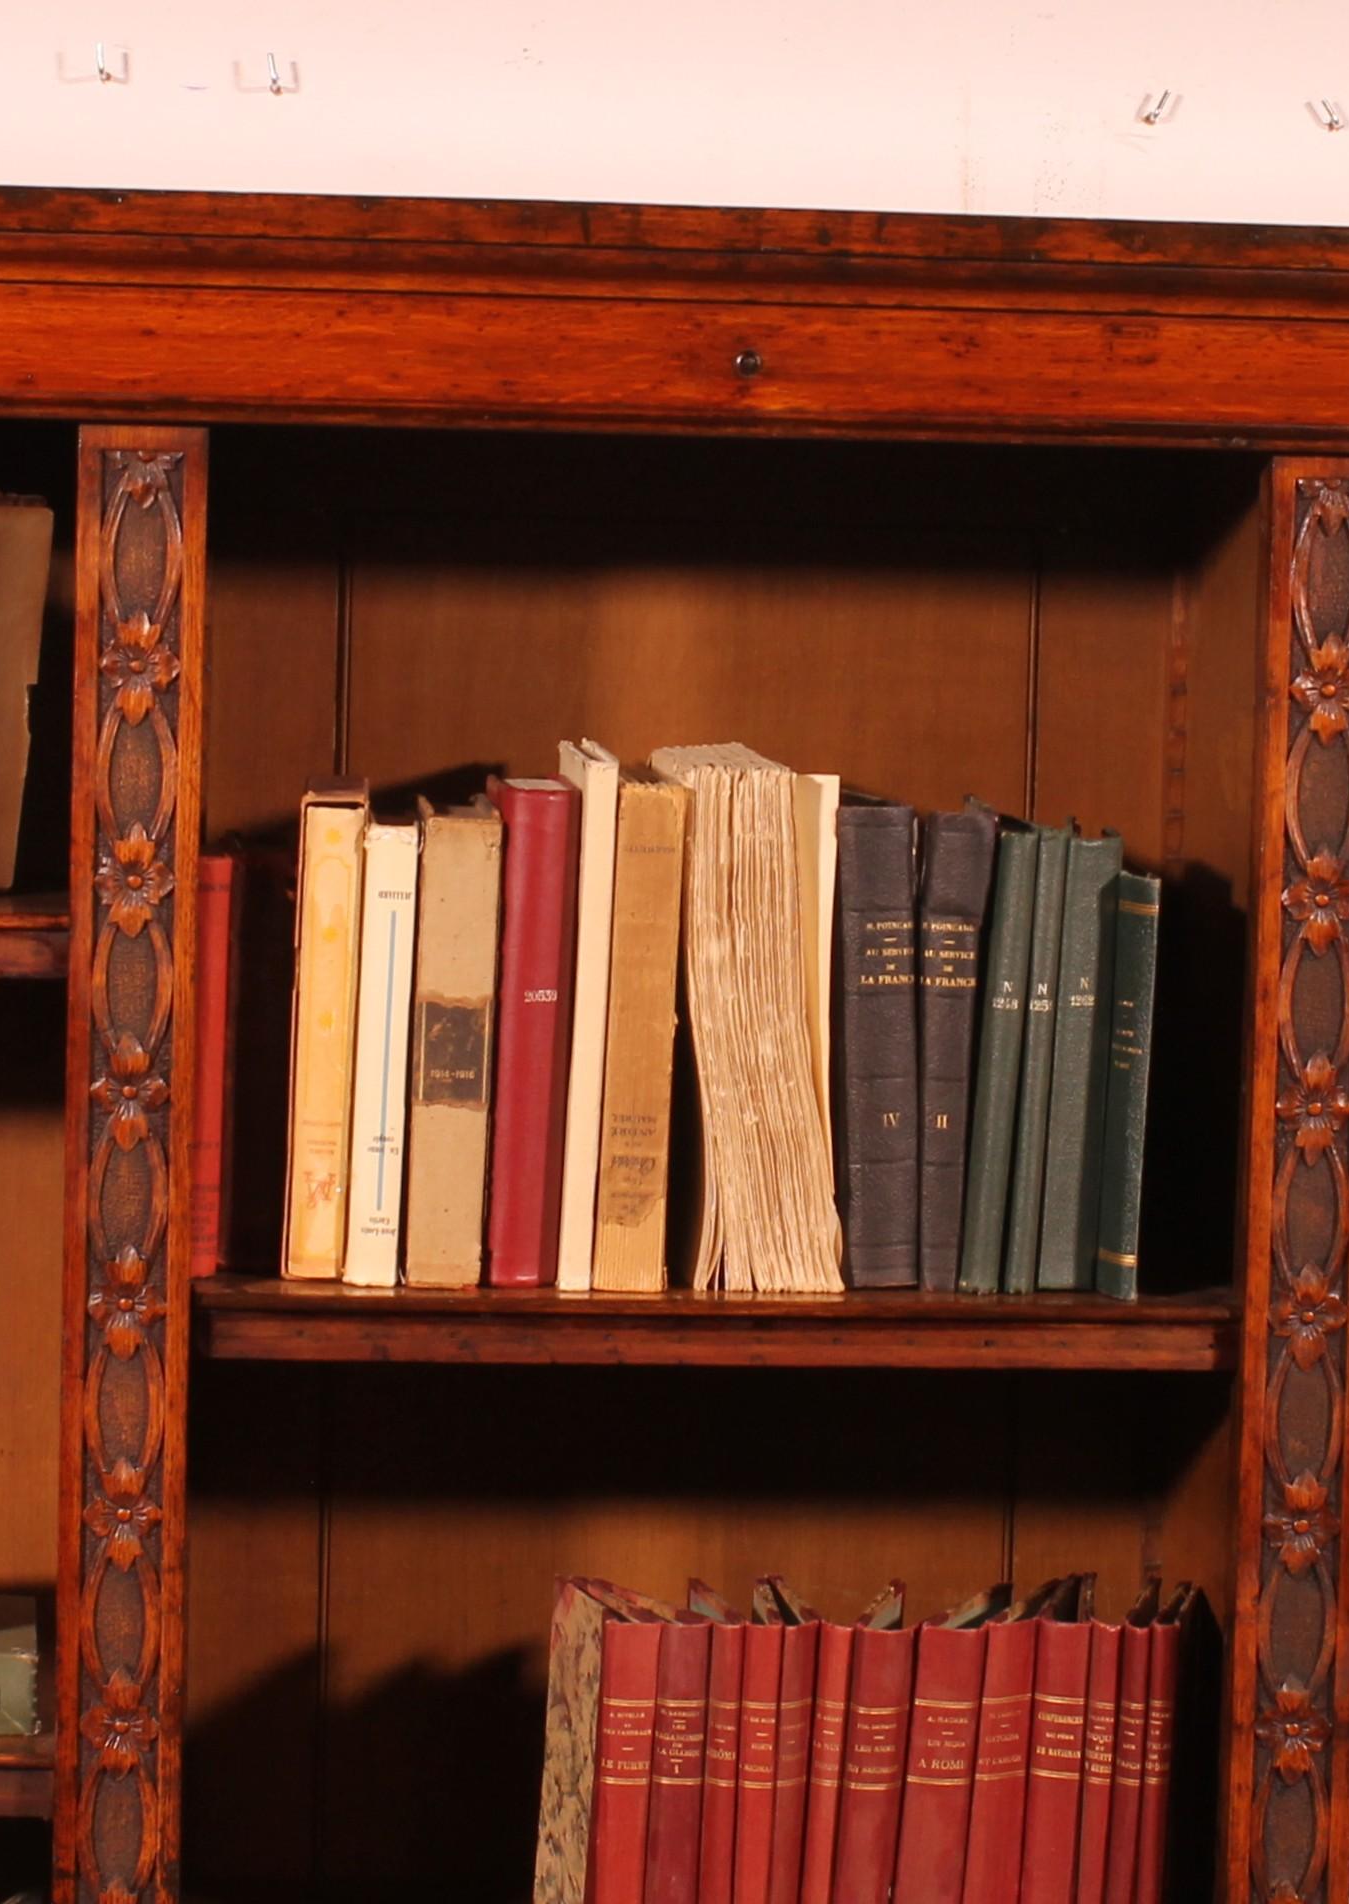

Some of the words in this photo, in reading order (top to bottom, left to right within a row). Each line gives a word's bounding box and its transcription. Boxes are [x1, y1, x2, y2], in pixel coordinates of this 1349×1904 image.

[860, 975, 875, 985] LA
[935, 976, 977, 987] FRANCE
[1003, 980, 1014, 993] N
[1080, 976, 1090, 990] N
[1037, 982, 1048, 996] N
[883, 1112, 901, 1128] IV
[936, 1114, 948, 1129] II
